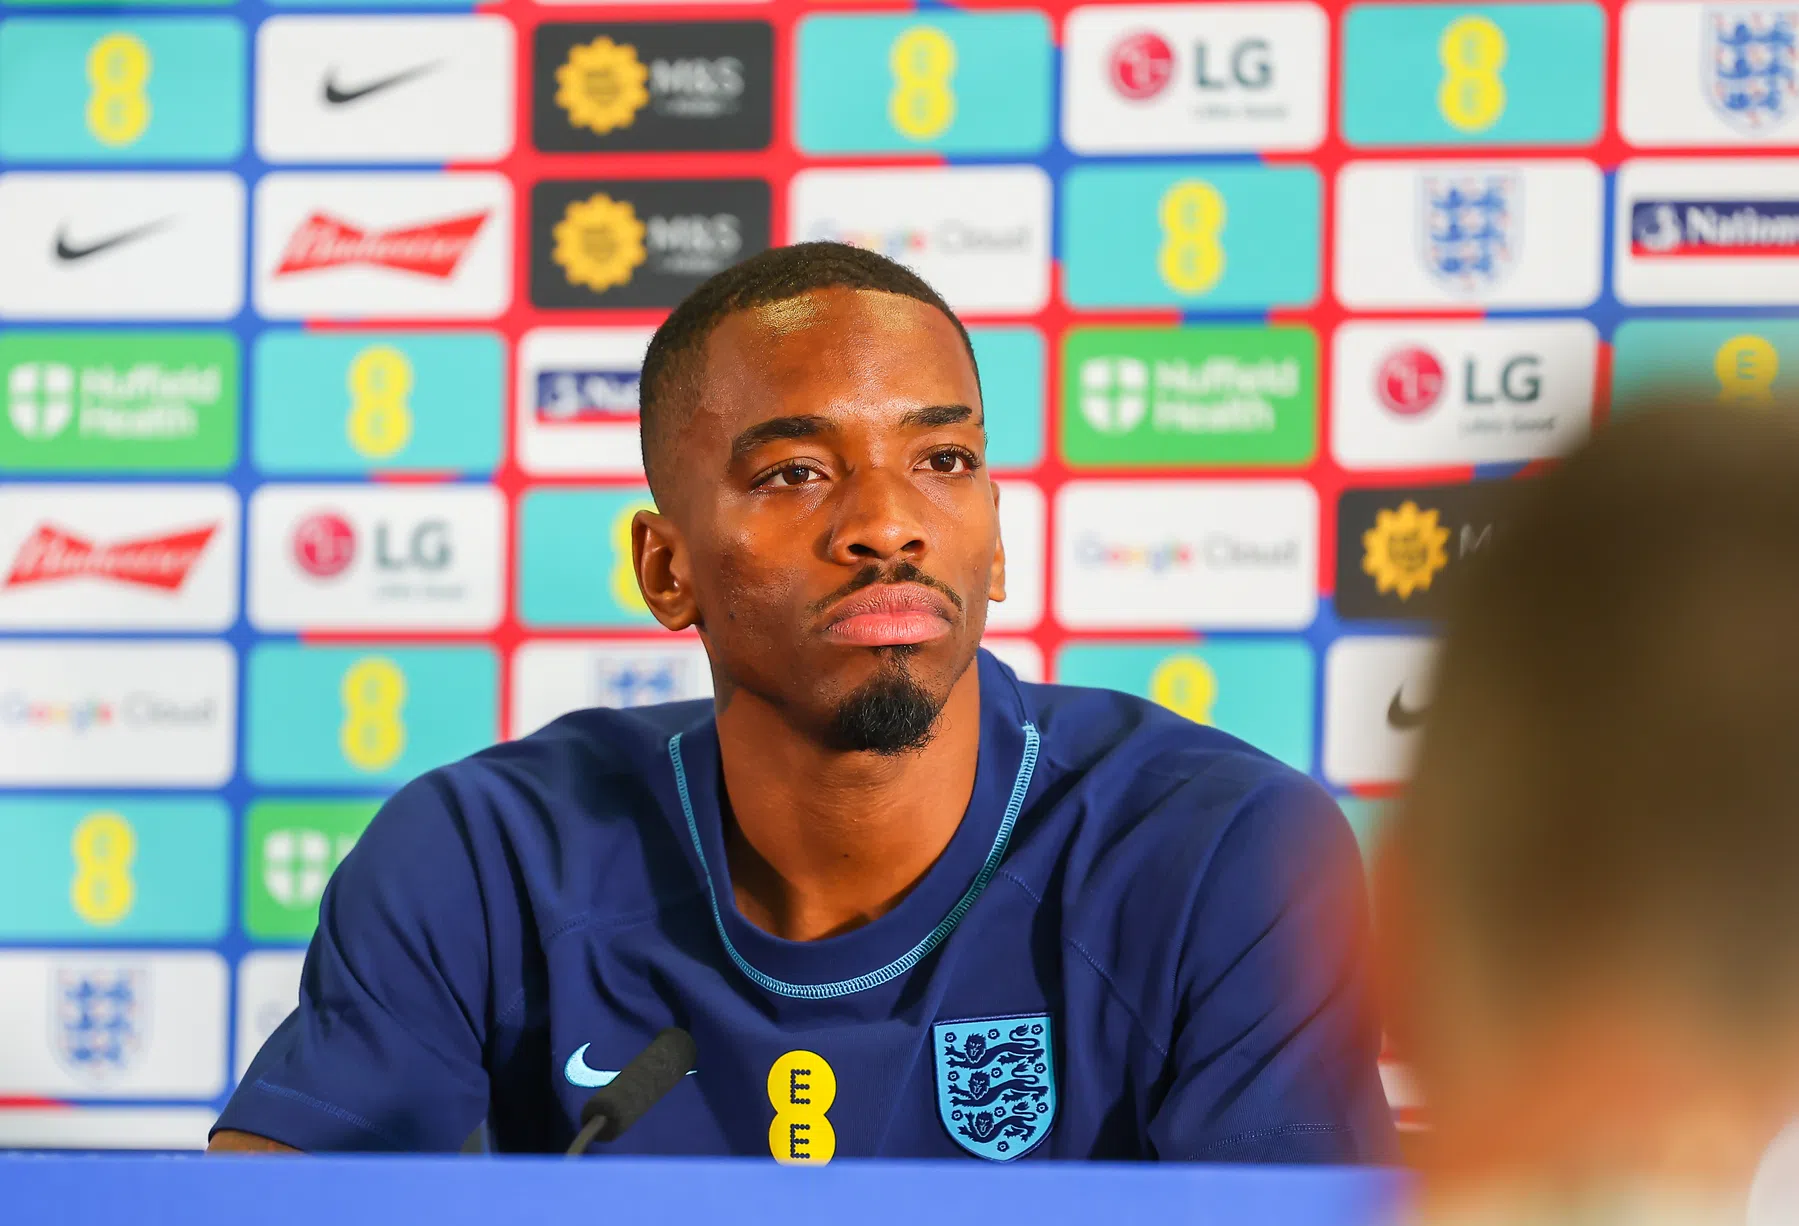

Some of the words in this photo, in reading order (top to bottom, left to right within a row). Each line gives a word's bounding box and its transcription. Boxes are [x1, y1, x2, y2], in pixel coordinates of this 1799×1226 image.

[1193, 37, 1274, 92] LG
[1463, 352, 1542, 405] LG
[373, 516, 456, 572] LG
